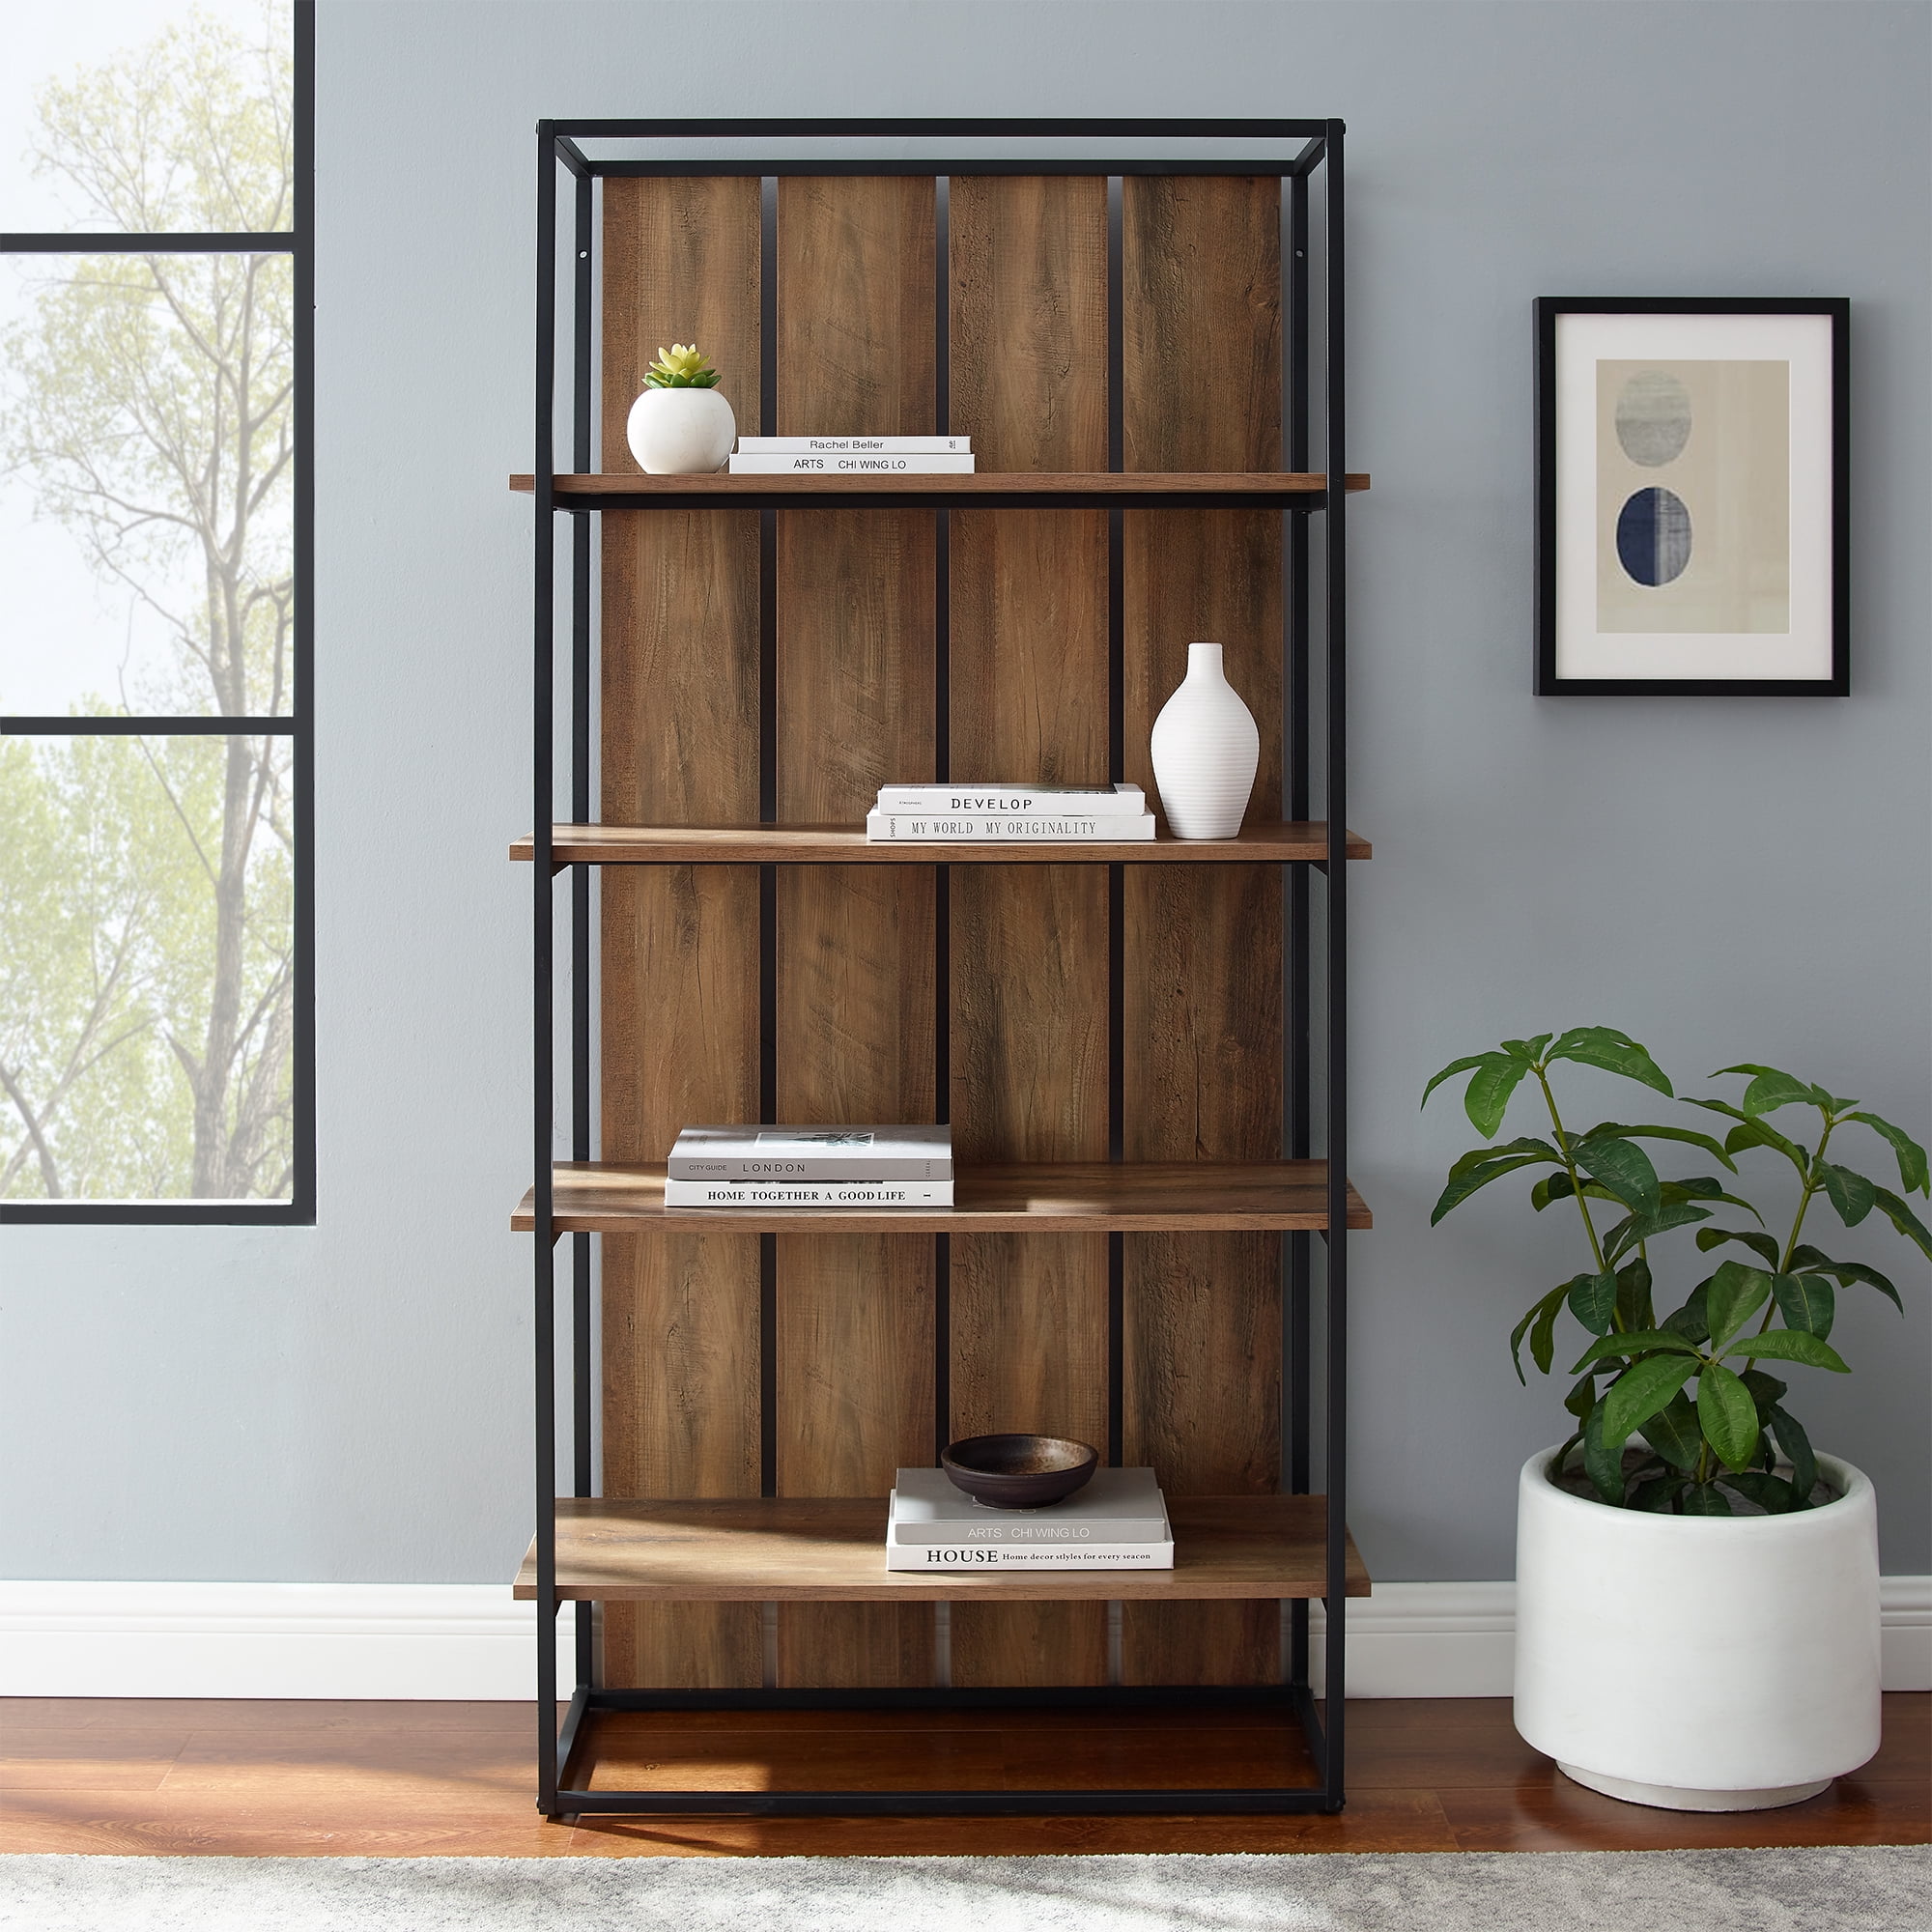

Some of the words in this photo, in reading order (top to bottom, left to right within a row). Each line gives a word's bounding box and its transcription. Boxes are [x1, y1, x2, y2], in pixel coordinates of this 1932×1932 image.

[810, 440, 848, 449] Rachel
[852, 440, 884, 449] Beller
[794, 460, 823, 469] ARTS
[952, 799, 1032, 810] DEVELOP
[912, 823, 926, 834] MY
[934, 822, 973, 834] WORLD
[986, 823, 1001, 834] MY
[1008, 822, 1095, 834] ORIGINALITY
[743, 1163, 805, 1173] LONDON
[707, 1190, 746, 1201] HOME
[750, 1190, 820, 1201] TOGETHER
[824, 1191, 834, 1201] A
[838, 1190, 875, 1201] GOOD
[876, 1190, 906, 1201] LIFE
[967, 1527, 1003, 1539] ARTS
[1010, 1527, 1033, 1539] CHI
[1036, 1527, 1070, 1539] WING
[1072, 1527, 1091, 1539] LO
[927, 1550, 998, 1562] HOUSE
[1097, 1553, 1120, 1562] every
